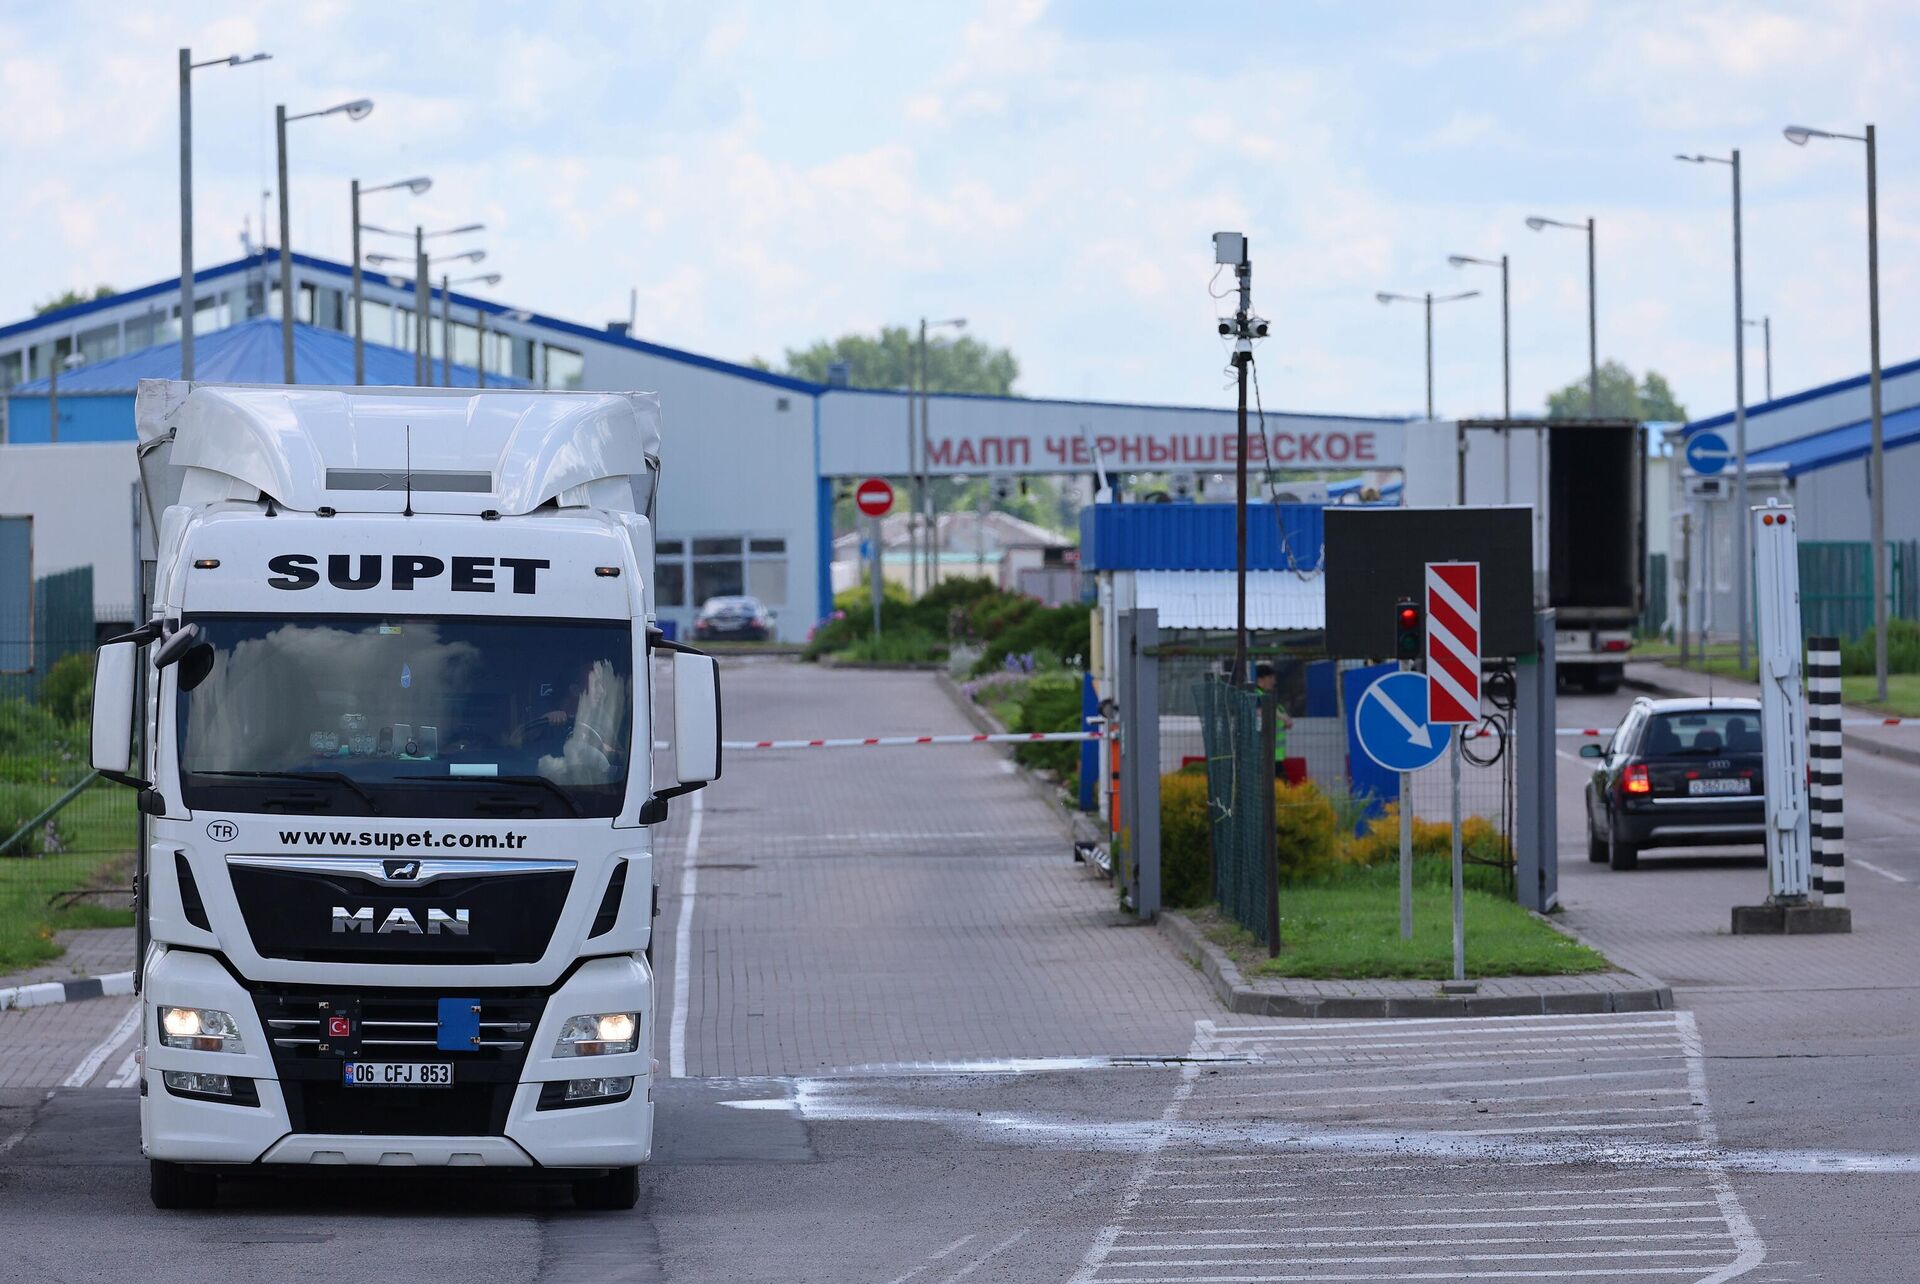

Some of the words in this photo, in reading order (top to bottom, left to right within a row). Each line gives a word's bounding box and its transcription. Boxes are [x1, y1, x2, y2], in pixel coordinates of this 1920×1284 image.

[926, 436, 1029, 465] МАПП
[1045, 433, 1376, 464] ЧЕРНЫШЕВСКОЕ
[267, 554, 550, 594] SUPET
[212, 825, 233, 837] TR
[279, 830, 528, 851] www.supet.com.tr
[331, 906, 470, 935] MAN
[355, 1064, 375, 1082] 06
[384, 1064, 413, 1082] CFJ
[420, 1065, 449, 1083] 853
